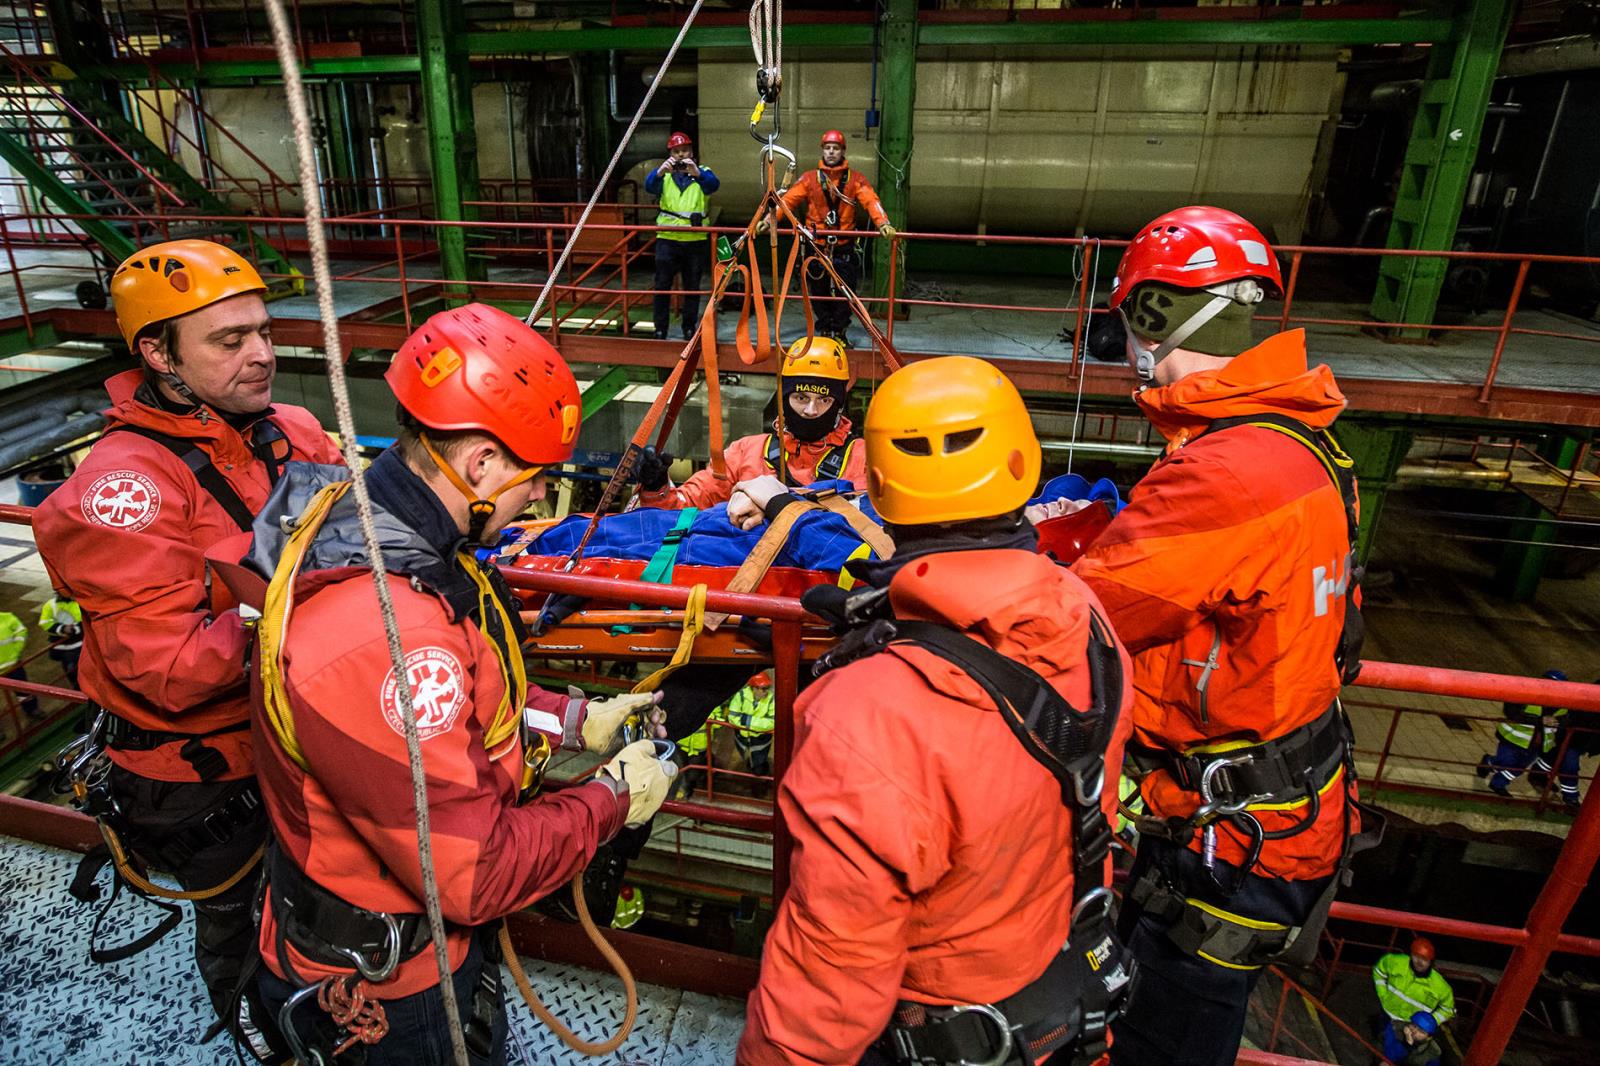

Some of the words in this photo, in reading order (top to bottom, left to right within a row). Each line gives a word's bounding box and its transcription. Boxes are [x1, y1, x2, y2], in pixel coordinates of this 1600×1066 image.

[795, 383, 830, 396] HASIČI
[91, 479, 107, 492] FIRE
[106, 472, 136, 482] RESCUE
[137, 475, 158, 498] SERVICE
[599, 449, 639, 511] SPENCER
[384, 677, 398, 700] FIRE
[426, 650, 456, 668] SERVICE
